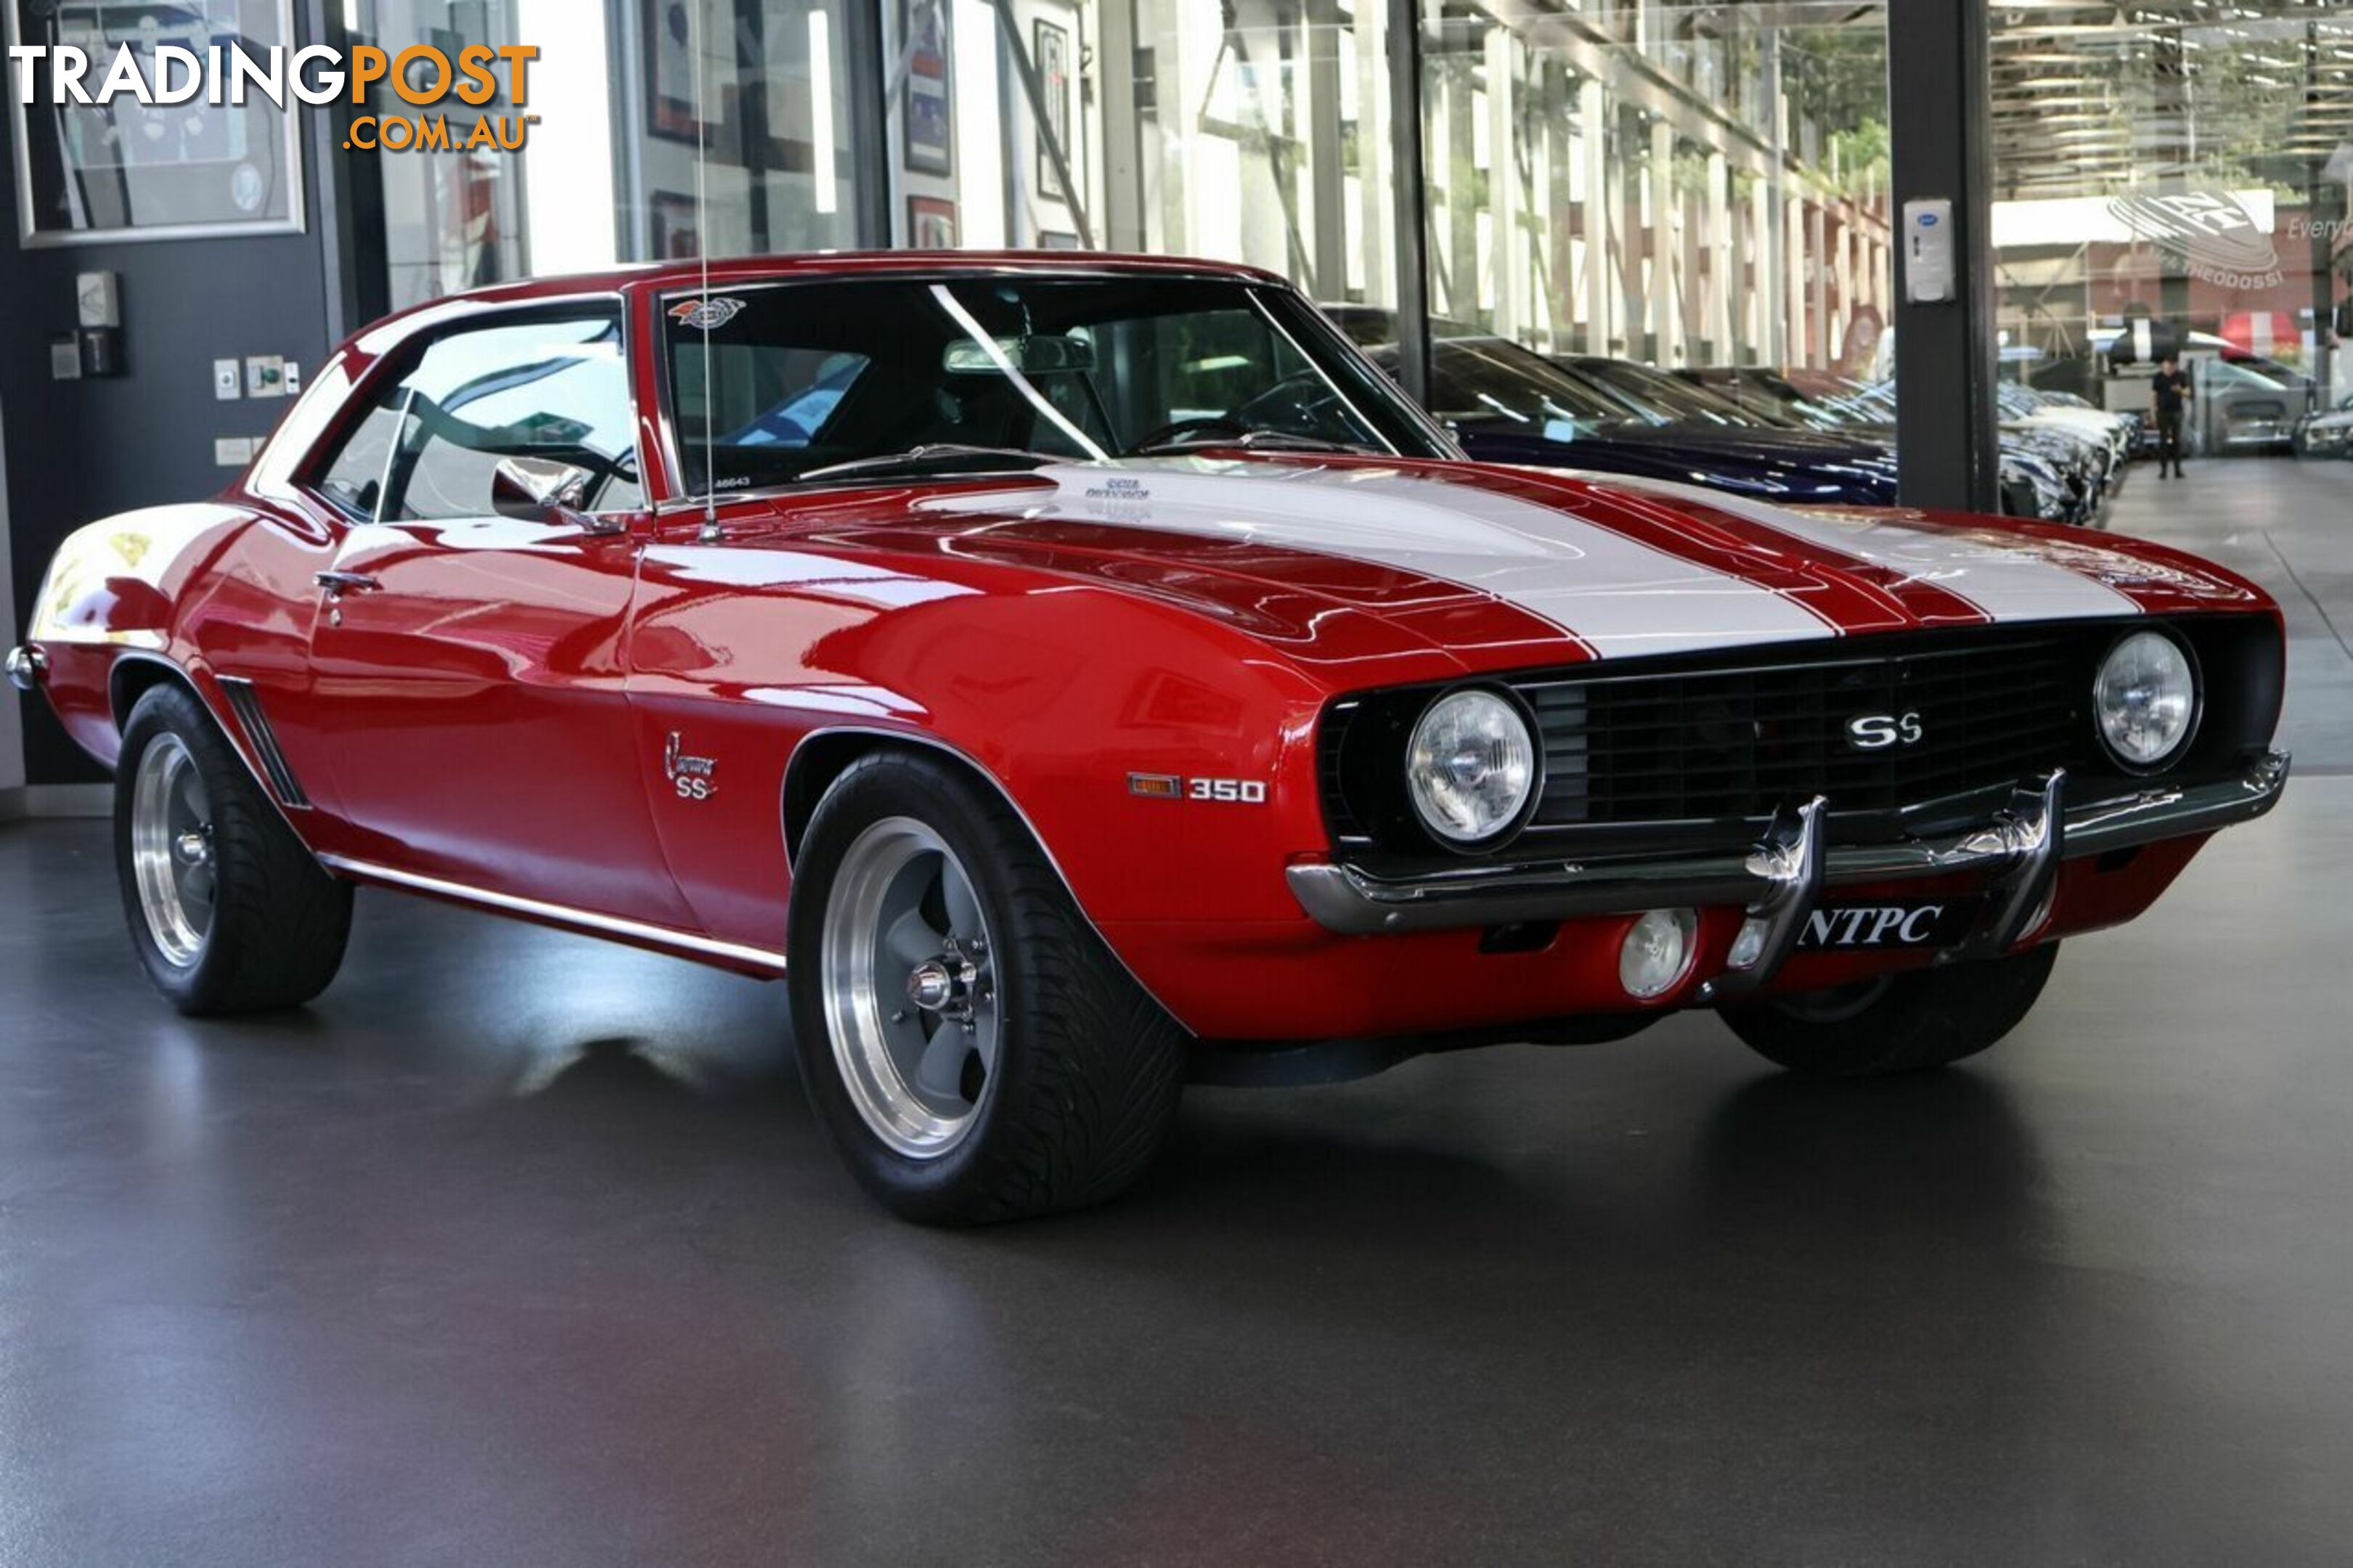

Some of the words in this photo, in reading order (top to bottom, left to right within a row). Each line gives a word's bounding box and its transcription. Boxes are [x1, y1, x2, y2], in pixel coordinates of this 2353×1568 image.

[2182, 258, 2285, 290] THEODOSSI
[1851, 711, 1922, 748] SS
[676, 776, 708, 800] SS
[1188, 777, 1266, 804] 350
[1797, 905, 1944, 946] NTPC
